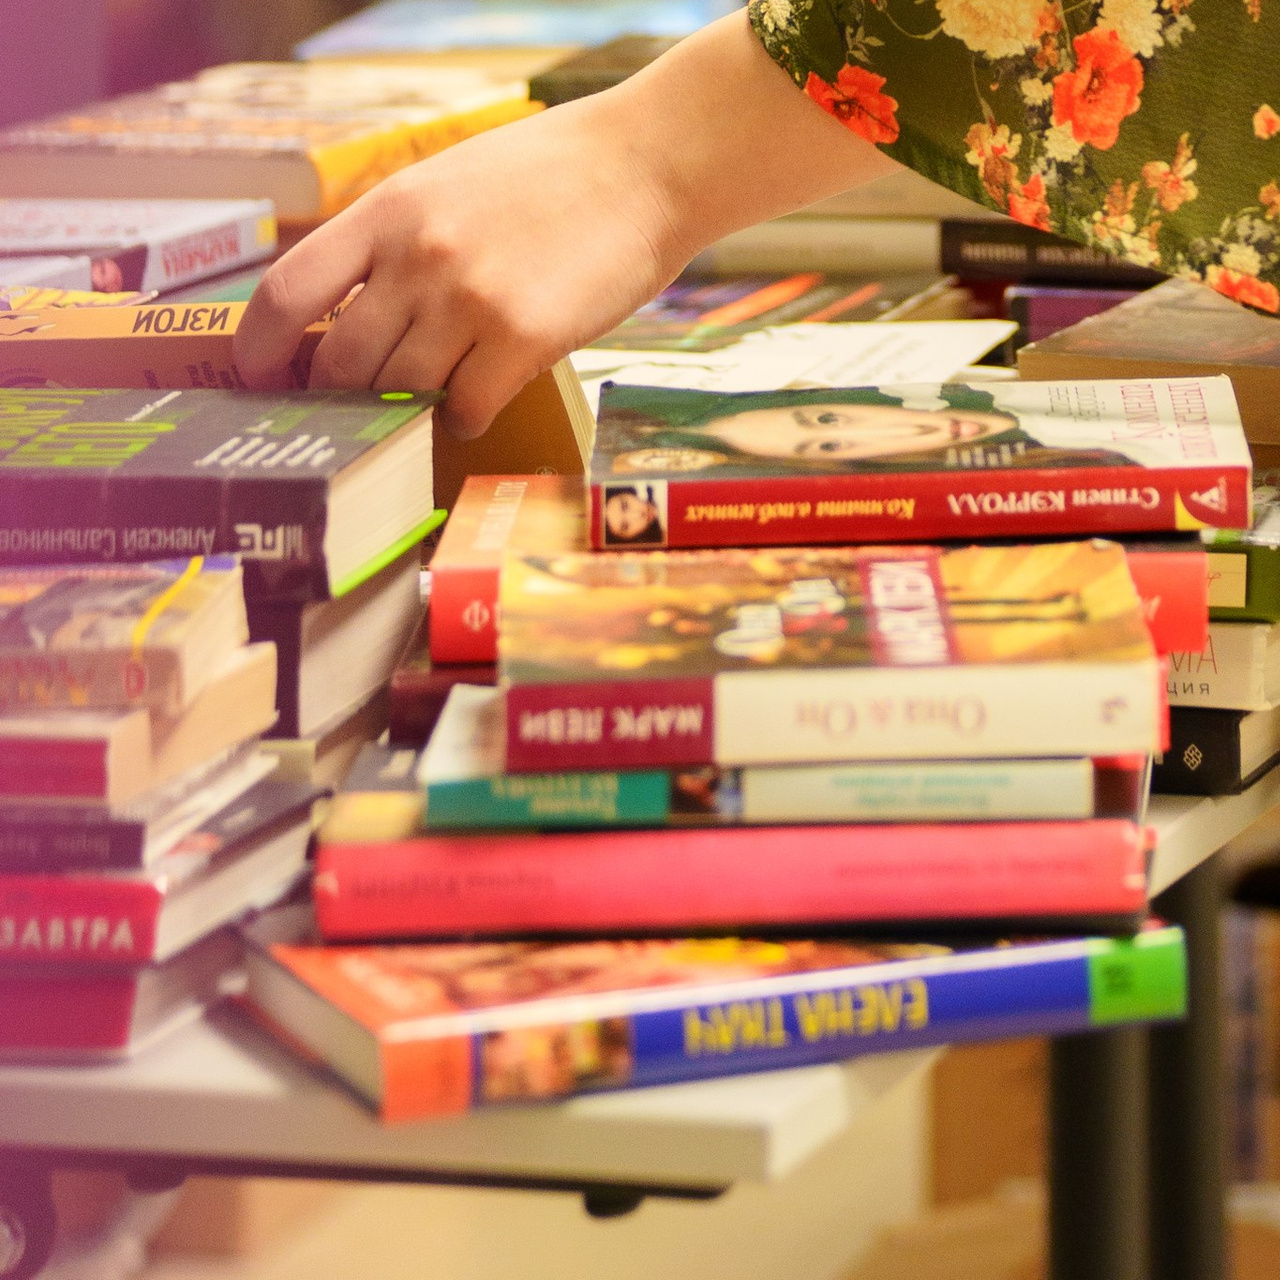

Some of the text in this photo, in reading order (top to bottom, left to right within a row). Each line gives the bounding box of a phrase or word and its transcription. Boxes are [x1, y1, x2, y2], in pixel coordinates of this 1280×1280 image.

[132, 306, 230, 335] ИЗГОИ
[814, 497, 915, 520] Комната
[946, 486, 1160, 516] Стивен КЭРРОЛЛ
[518, 703, 704, 745] МАРК ЛЕВИ
